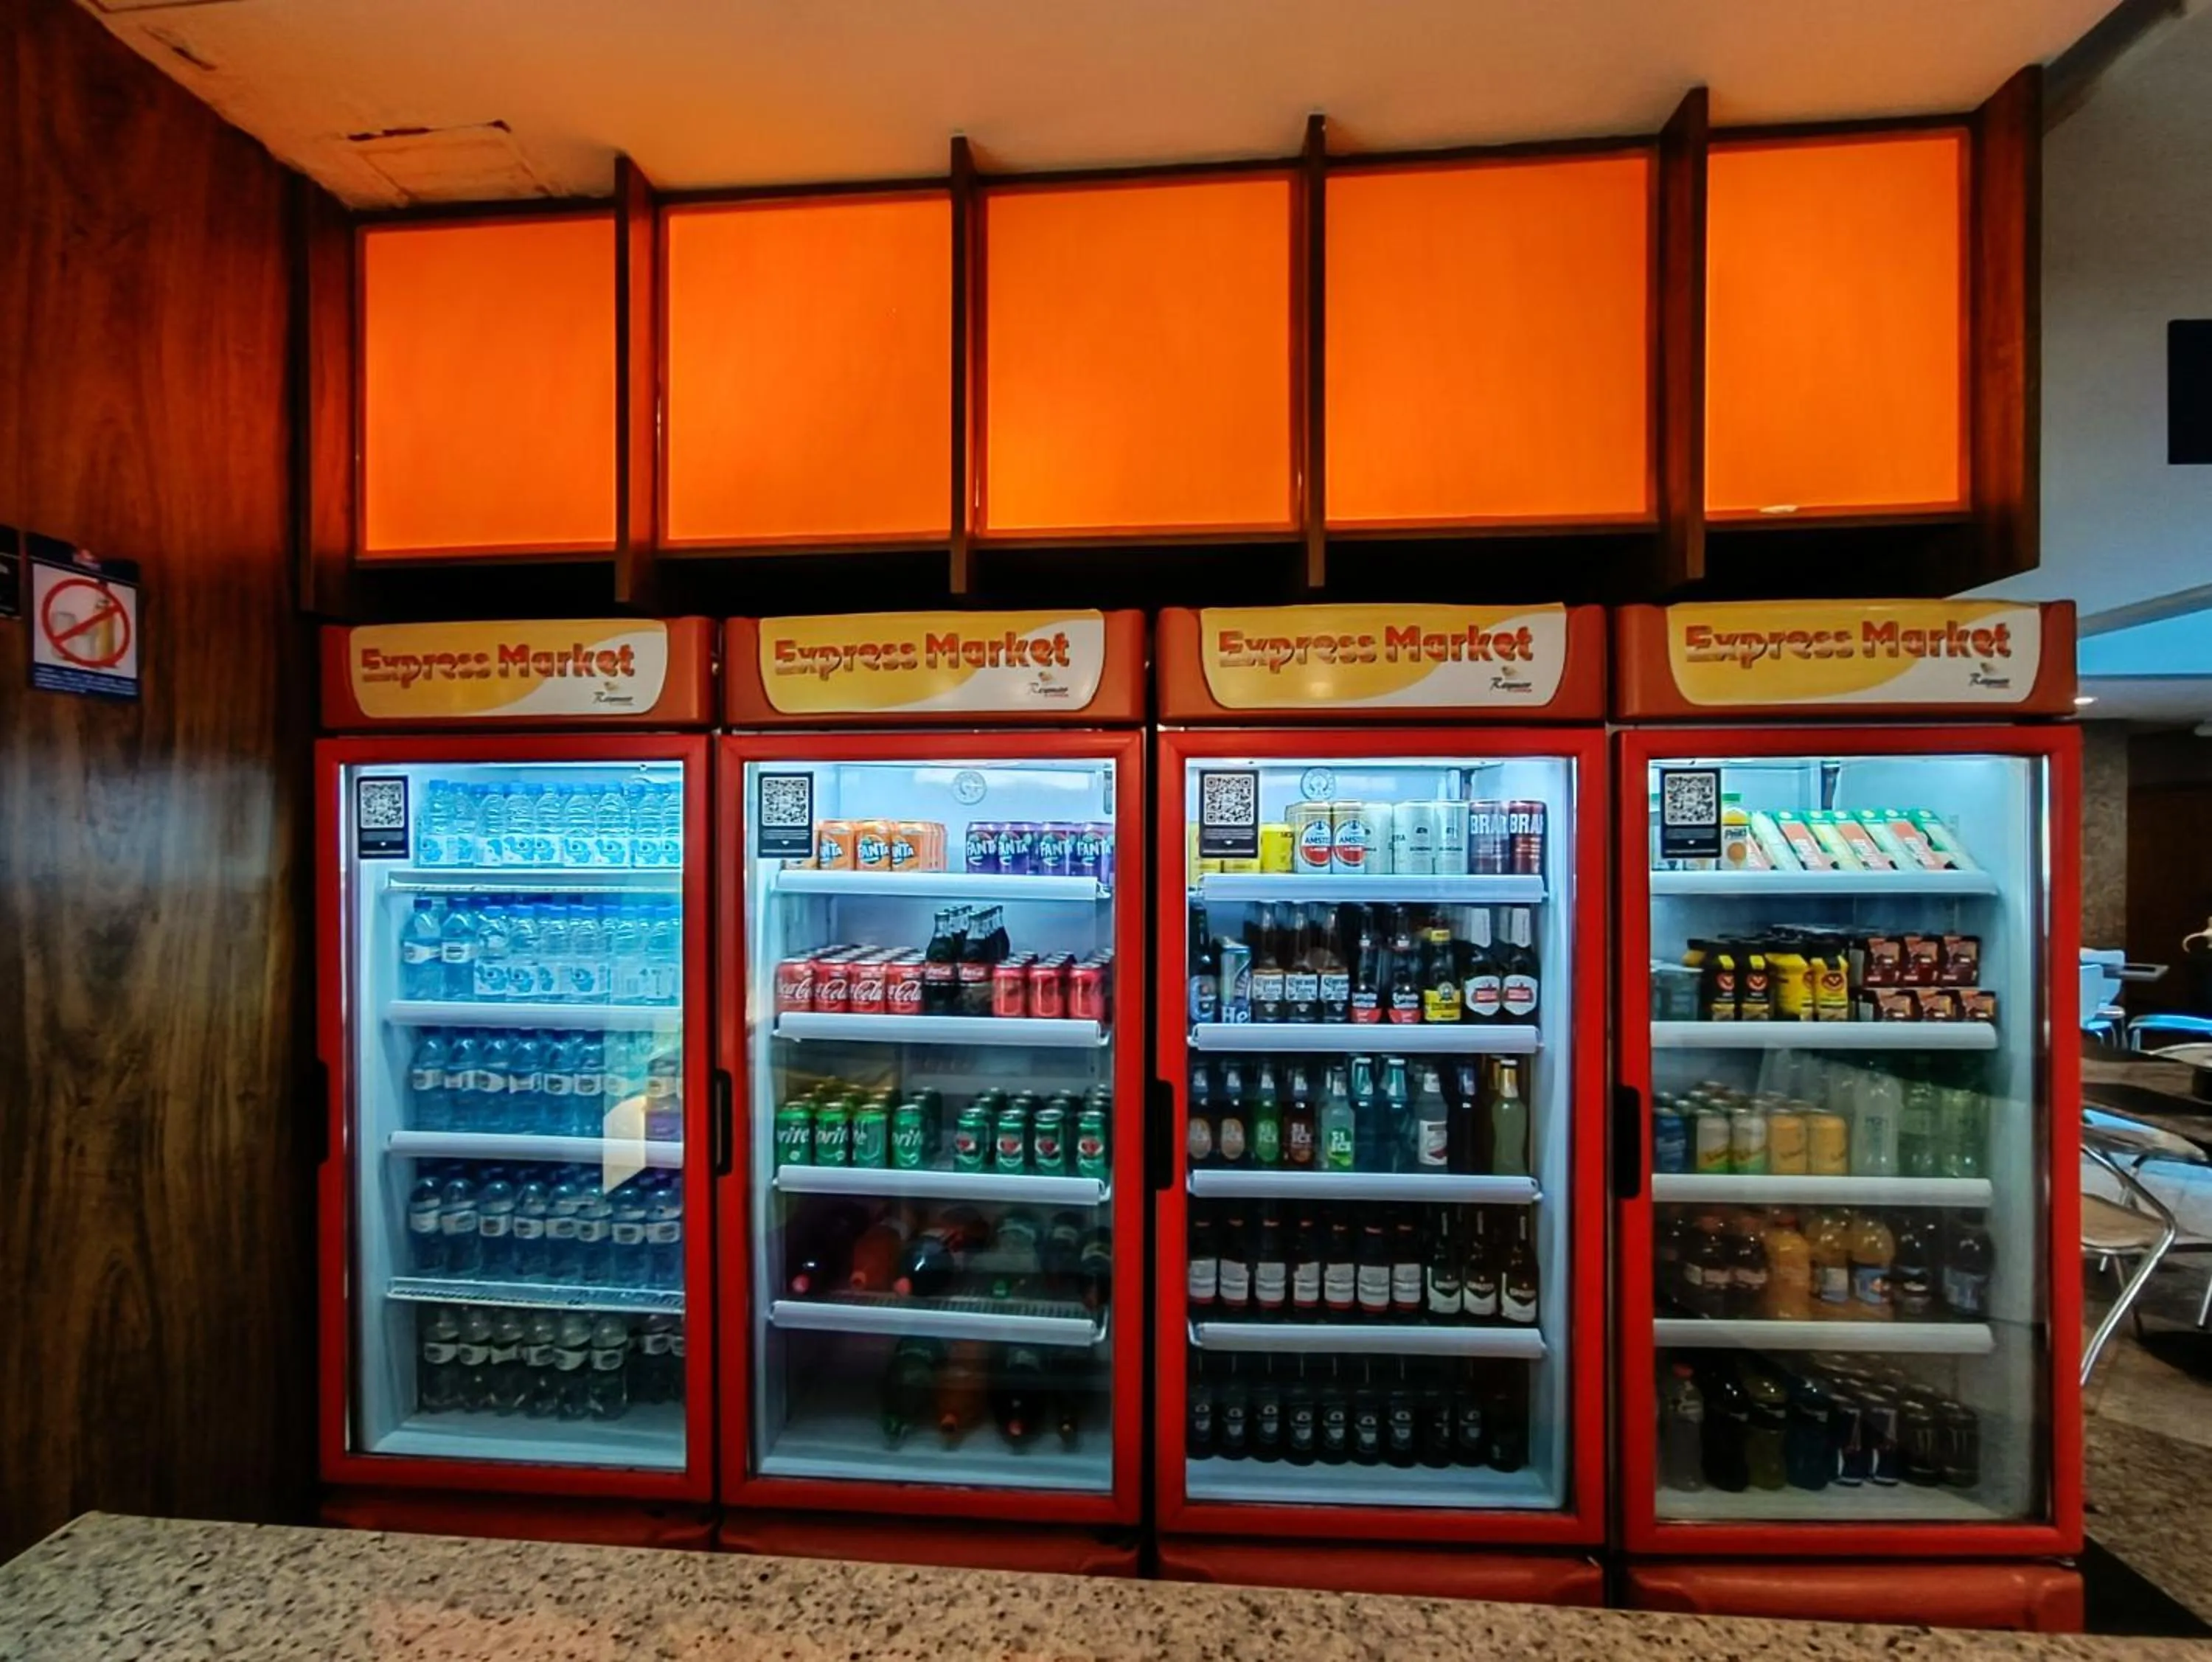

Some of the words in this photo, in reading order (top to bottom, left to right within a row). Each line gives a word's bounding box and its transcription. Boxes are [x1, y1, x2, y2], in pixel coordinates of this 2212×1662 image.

[361, 648, 490, 689] Express
[498, 644, 636, 678] Market
[774, 639, 919, 681] Express
[925, 631, 1070, 670] Market
[1219, 630, 1377, 674] Express
[1385, 625, 1534, 663] Market
[1686, 625, 1854, 669] Express
[1863, 620, 2011, 658] Market
